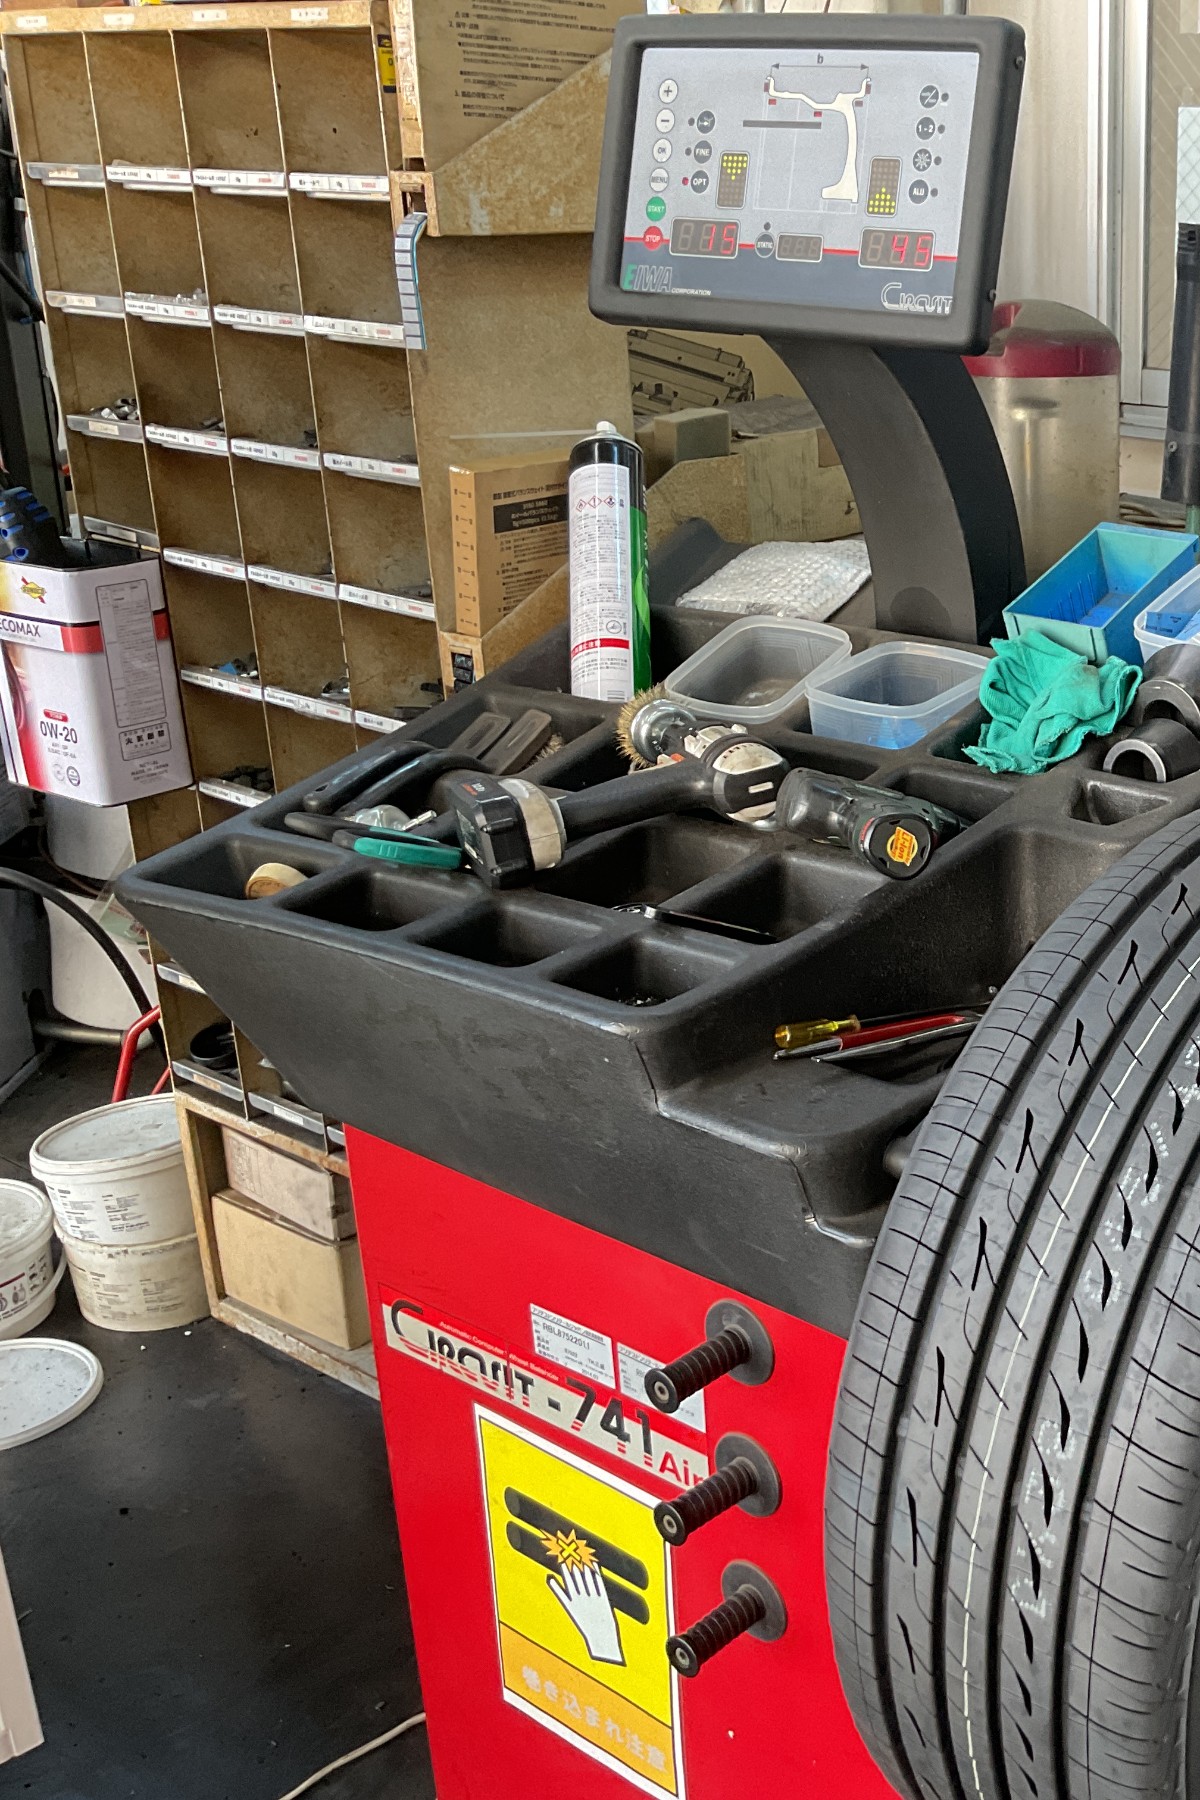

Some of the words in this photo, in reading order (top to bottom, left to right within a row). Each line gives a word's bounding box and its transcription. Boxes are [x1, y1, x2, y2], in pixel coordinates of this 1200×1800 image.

[694, 148, 711, 157] FINE
[650, 176, 669, 184] MENU
[692, 178, 707, 186] OPT
[911, 187, 925, 196] ALU
[647, 205, 665, 213] START
[644, 234, 661, 243] STOP
[707, 223, 737, 255] 15
[756, 241, 774, 250] STATIC
[891, 234, 933, 267] 45
[622, 263, 673, 292] EIWA
[671, 287, 712, 297] CORPORATION
[0, 618, 41, 638] COMAX
[40, 720, 78, 744] 0W-20
